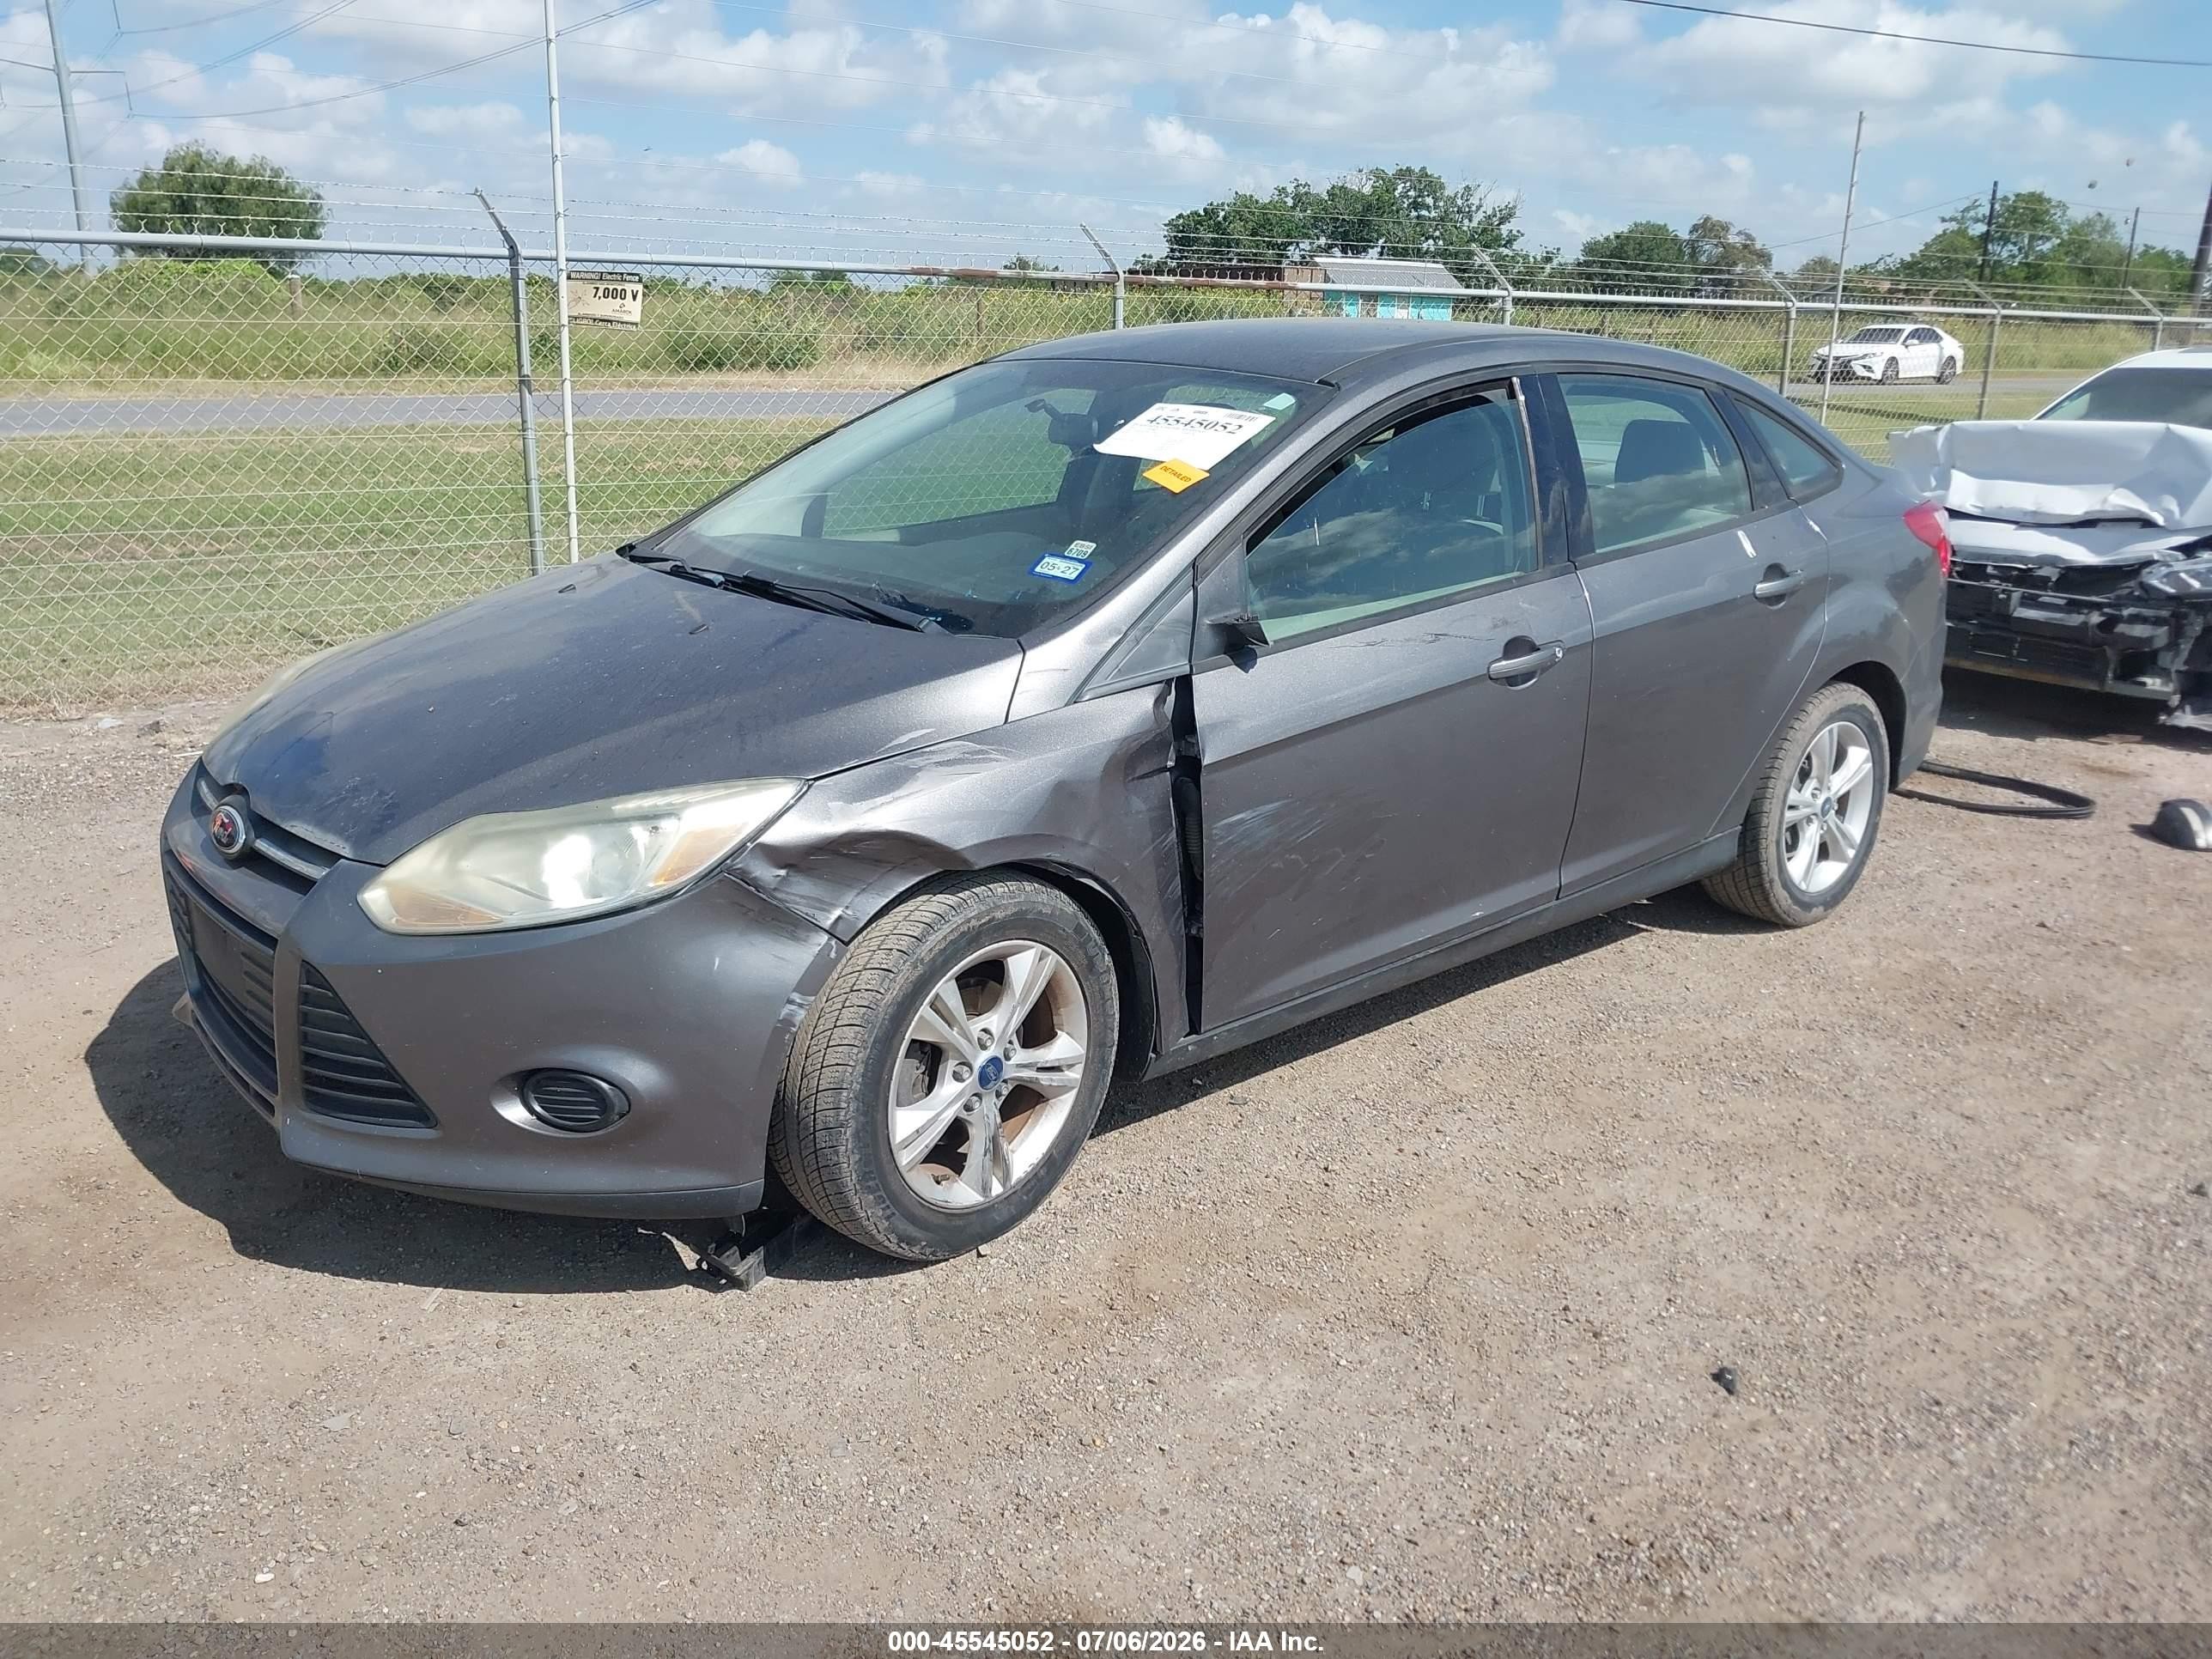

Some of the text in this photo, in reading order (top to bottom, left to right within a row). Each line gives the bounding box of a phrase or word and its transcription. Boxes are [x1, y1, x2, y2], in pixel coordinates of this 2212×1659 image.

[570, 271, 640, 283] WARNING! Electric Fence
[592, 286, 639, 302] 7,000 V
[1146, 415, 1244, 434] 45545052
[1159, 465, 1192, 483] DETAILED
[1066, 547, 1089, 557] 6709
[1060, 565, 1079, 575] 27
